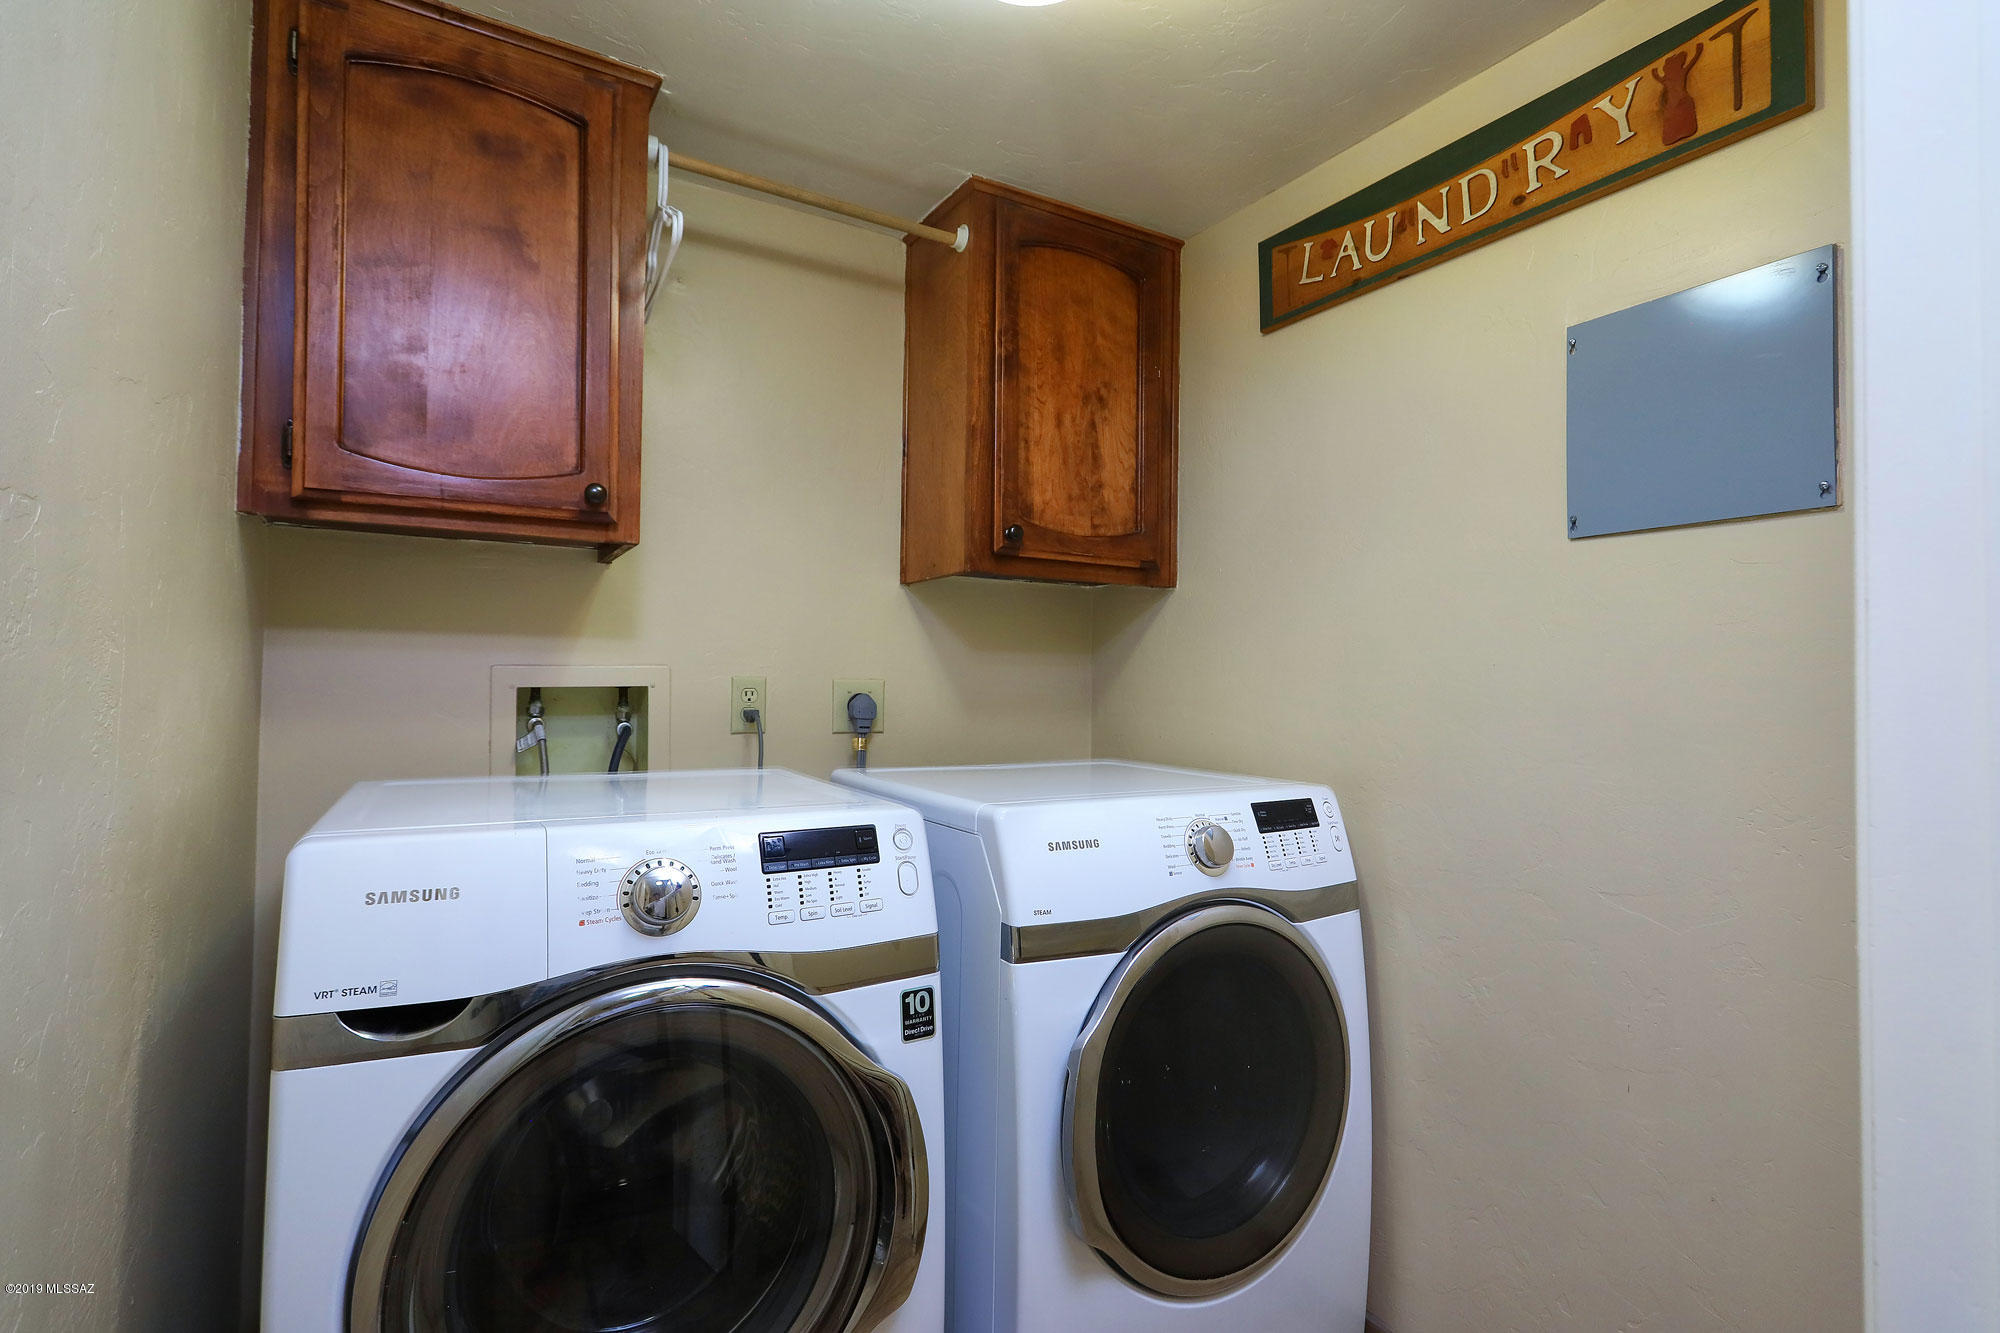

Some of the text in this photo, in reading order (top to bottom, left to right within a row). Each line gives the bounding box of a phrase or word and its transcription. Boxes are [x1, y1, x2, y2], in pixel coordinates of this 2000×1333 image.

[1047, 839, 1100, 851] SAMSUNG
[365, 887, 461, 906] SAMSUNG
[604, 916, 622, 924] Cycles
[341, 985, 378, 997] STEAM
[905, 991, 930, 1015] 10
[904, 1016, 932, 1025] WARRANTY
[904, 1027, 920, 1036] Direct
